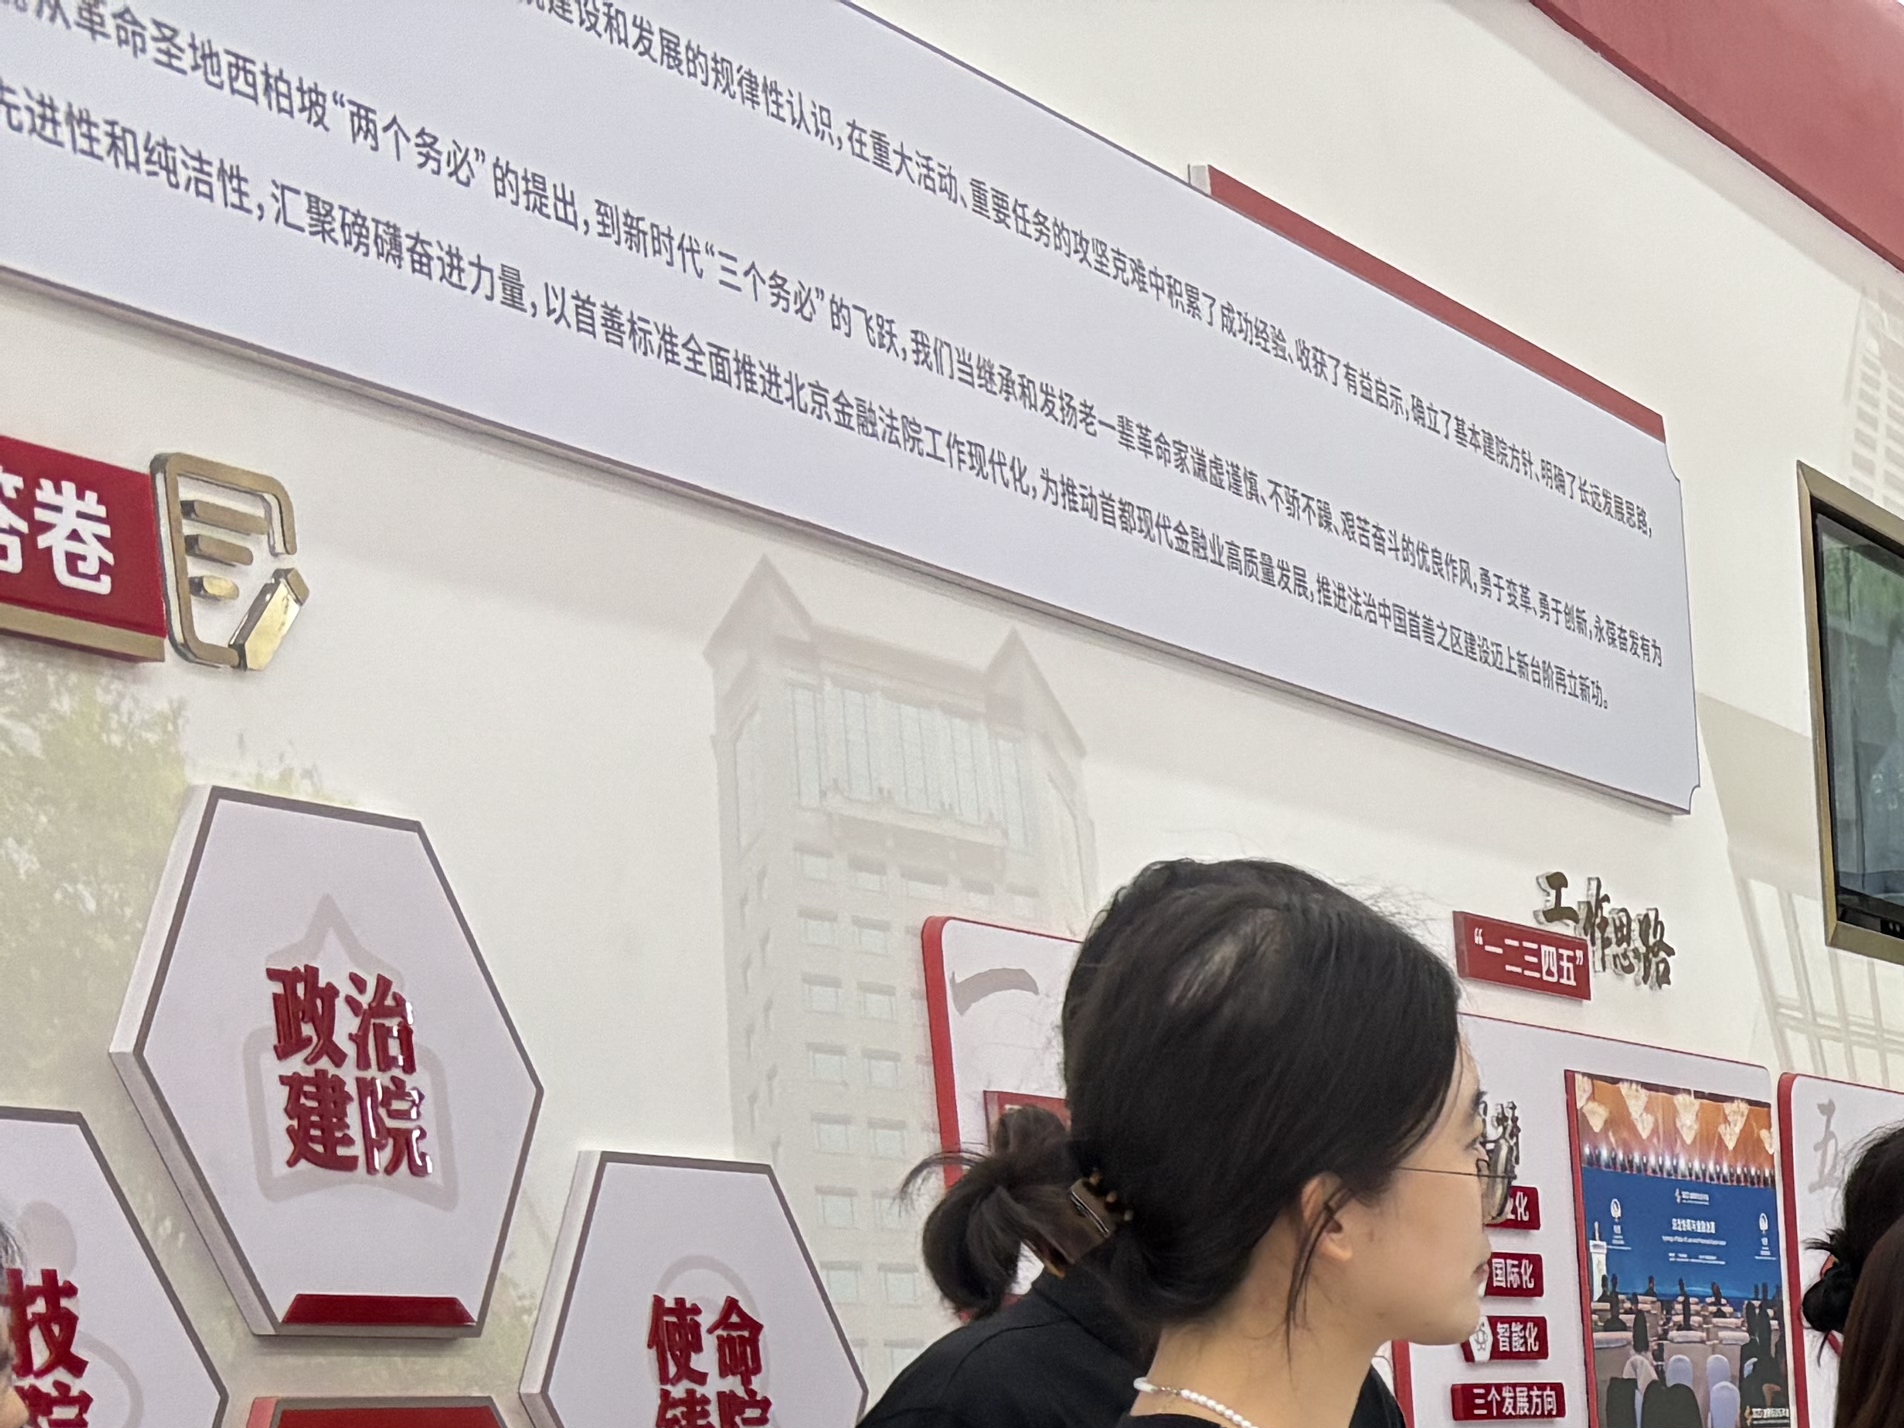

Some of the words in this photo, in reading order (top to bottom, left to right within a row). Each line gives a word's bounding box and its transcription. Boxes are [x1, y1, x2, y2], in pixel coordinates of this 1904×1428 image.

[266, 966, 417, 1073] 政治
[279, 1071, 432, 1178] 建院
[1491, 1257, 1535, 1290] 国际化
[648, 1294, 764, 1389] 使命
[1497, 1321, 1539, 1353] 智能化
[1473, 1381, 1558, 1417] 三个发展方向
